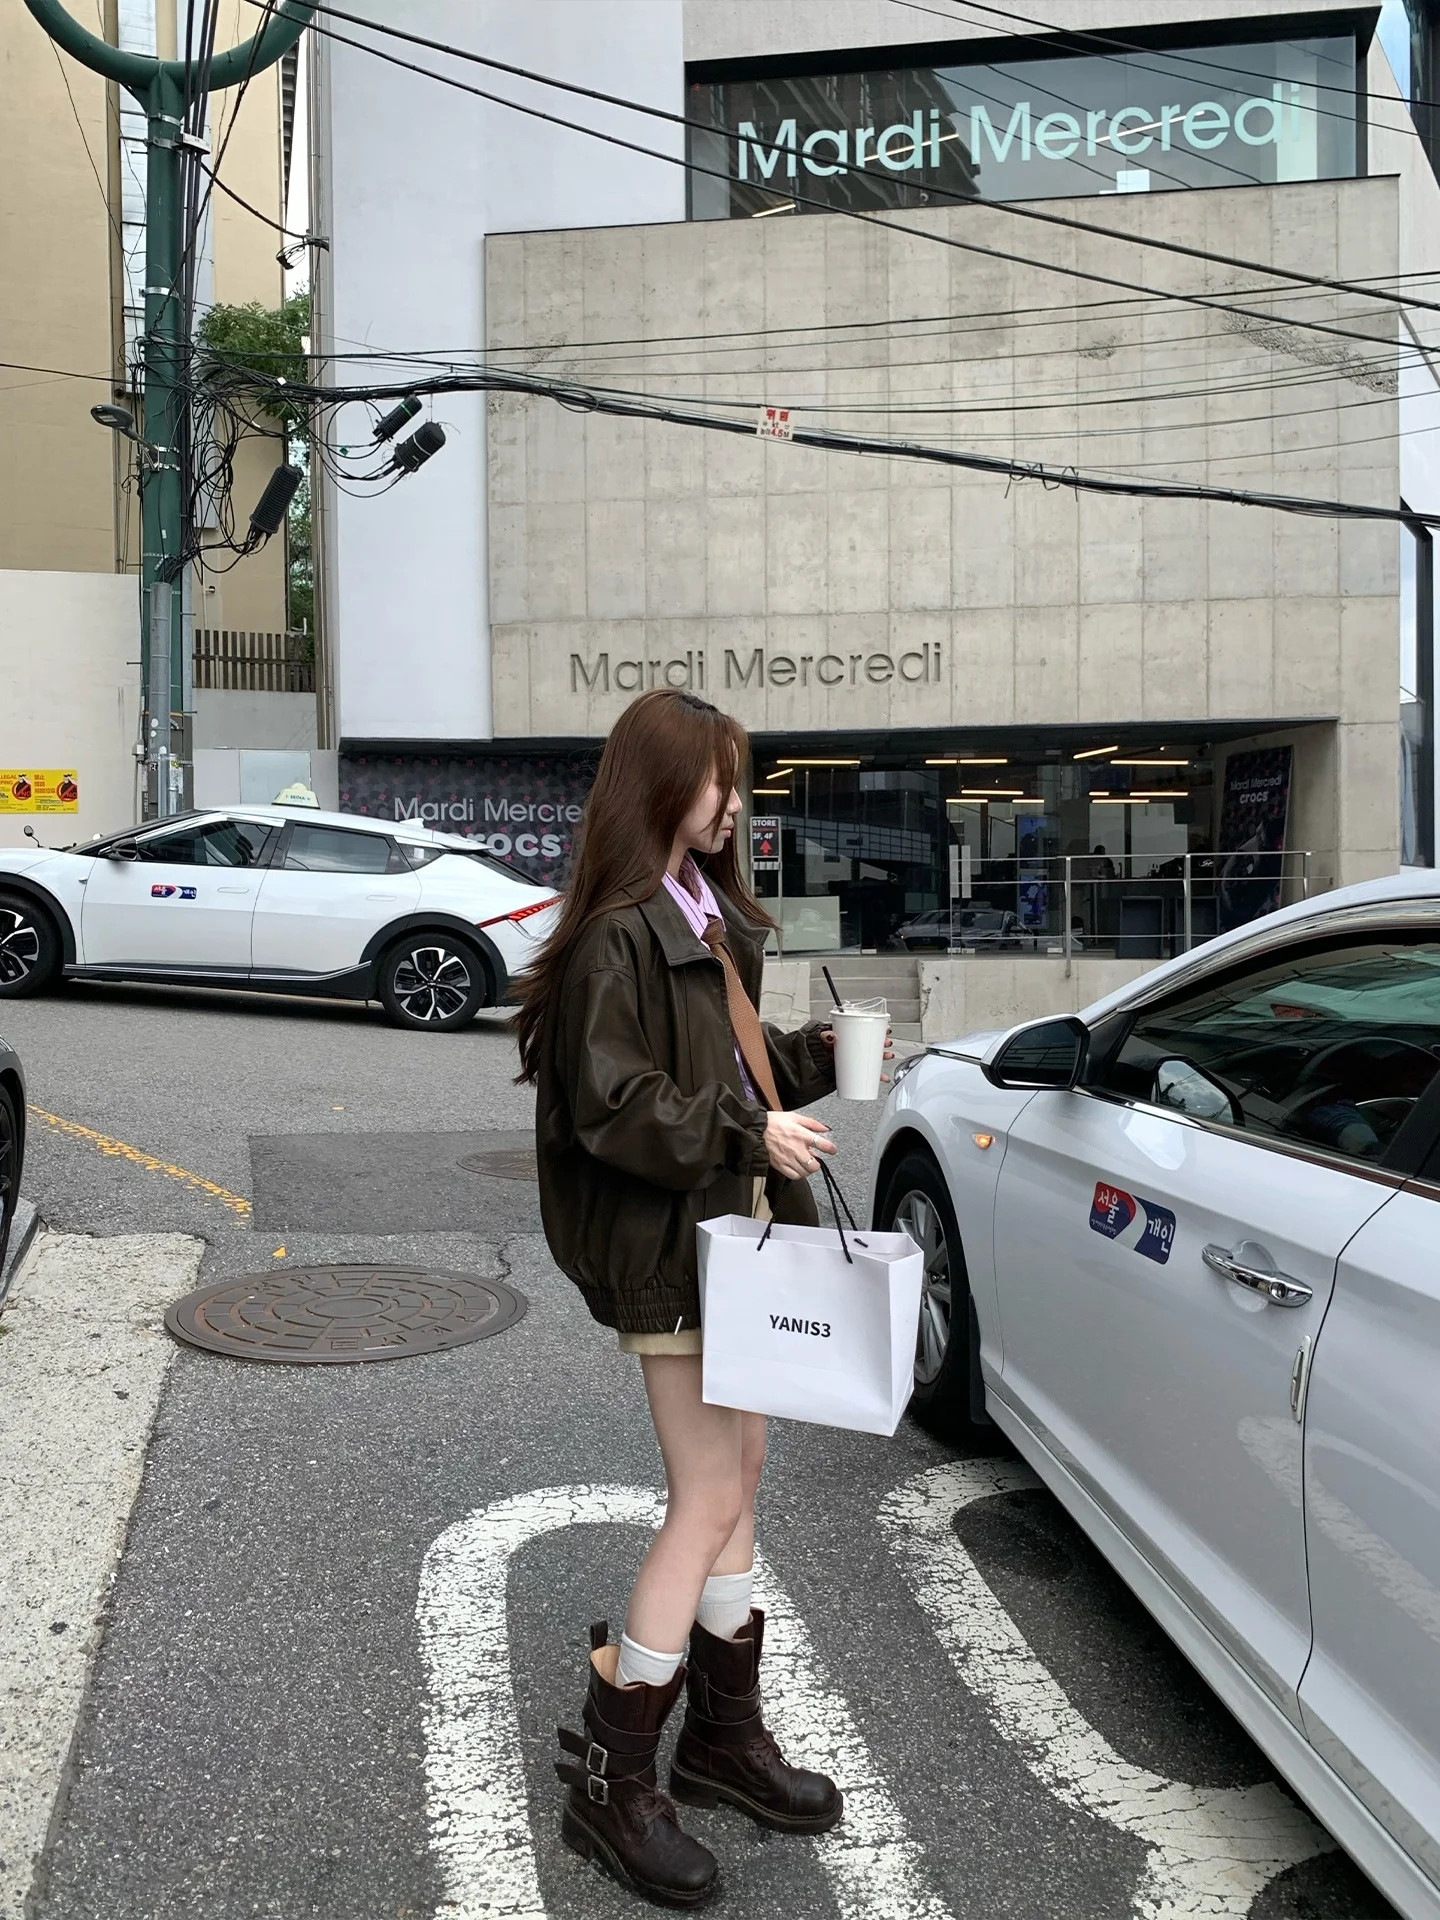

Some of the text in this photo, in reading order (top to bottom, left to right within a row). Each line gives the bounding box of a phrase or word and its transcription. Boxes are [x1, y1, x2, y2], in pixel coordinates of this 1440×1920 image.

[738, 83, 1300, 180] Mardi Mercredi
[570, 643, 941, 692] Mardi Mercredi
[1230, 774, 1283, 791] Mardi Mercredi
[1239, 791, 1269, 804] crocs
[394, 797, 583, 823] Mardi Mercre
[752, 819, 777, 827] STORE
[764, 832, 773, 840] 4F
[1098, 1189, 1119, 1224] 서울
[1148, 1218, 1174, 1253] 개인
[769, 1314, 831, 1338] YANIS3
